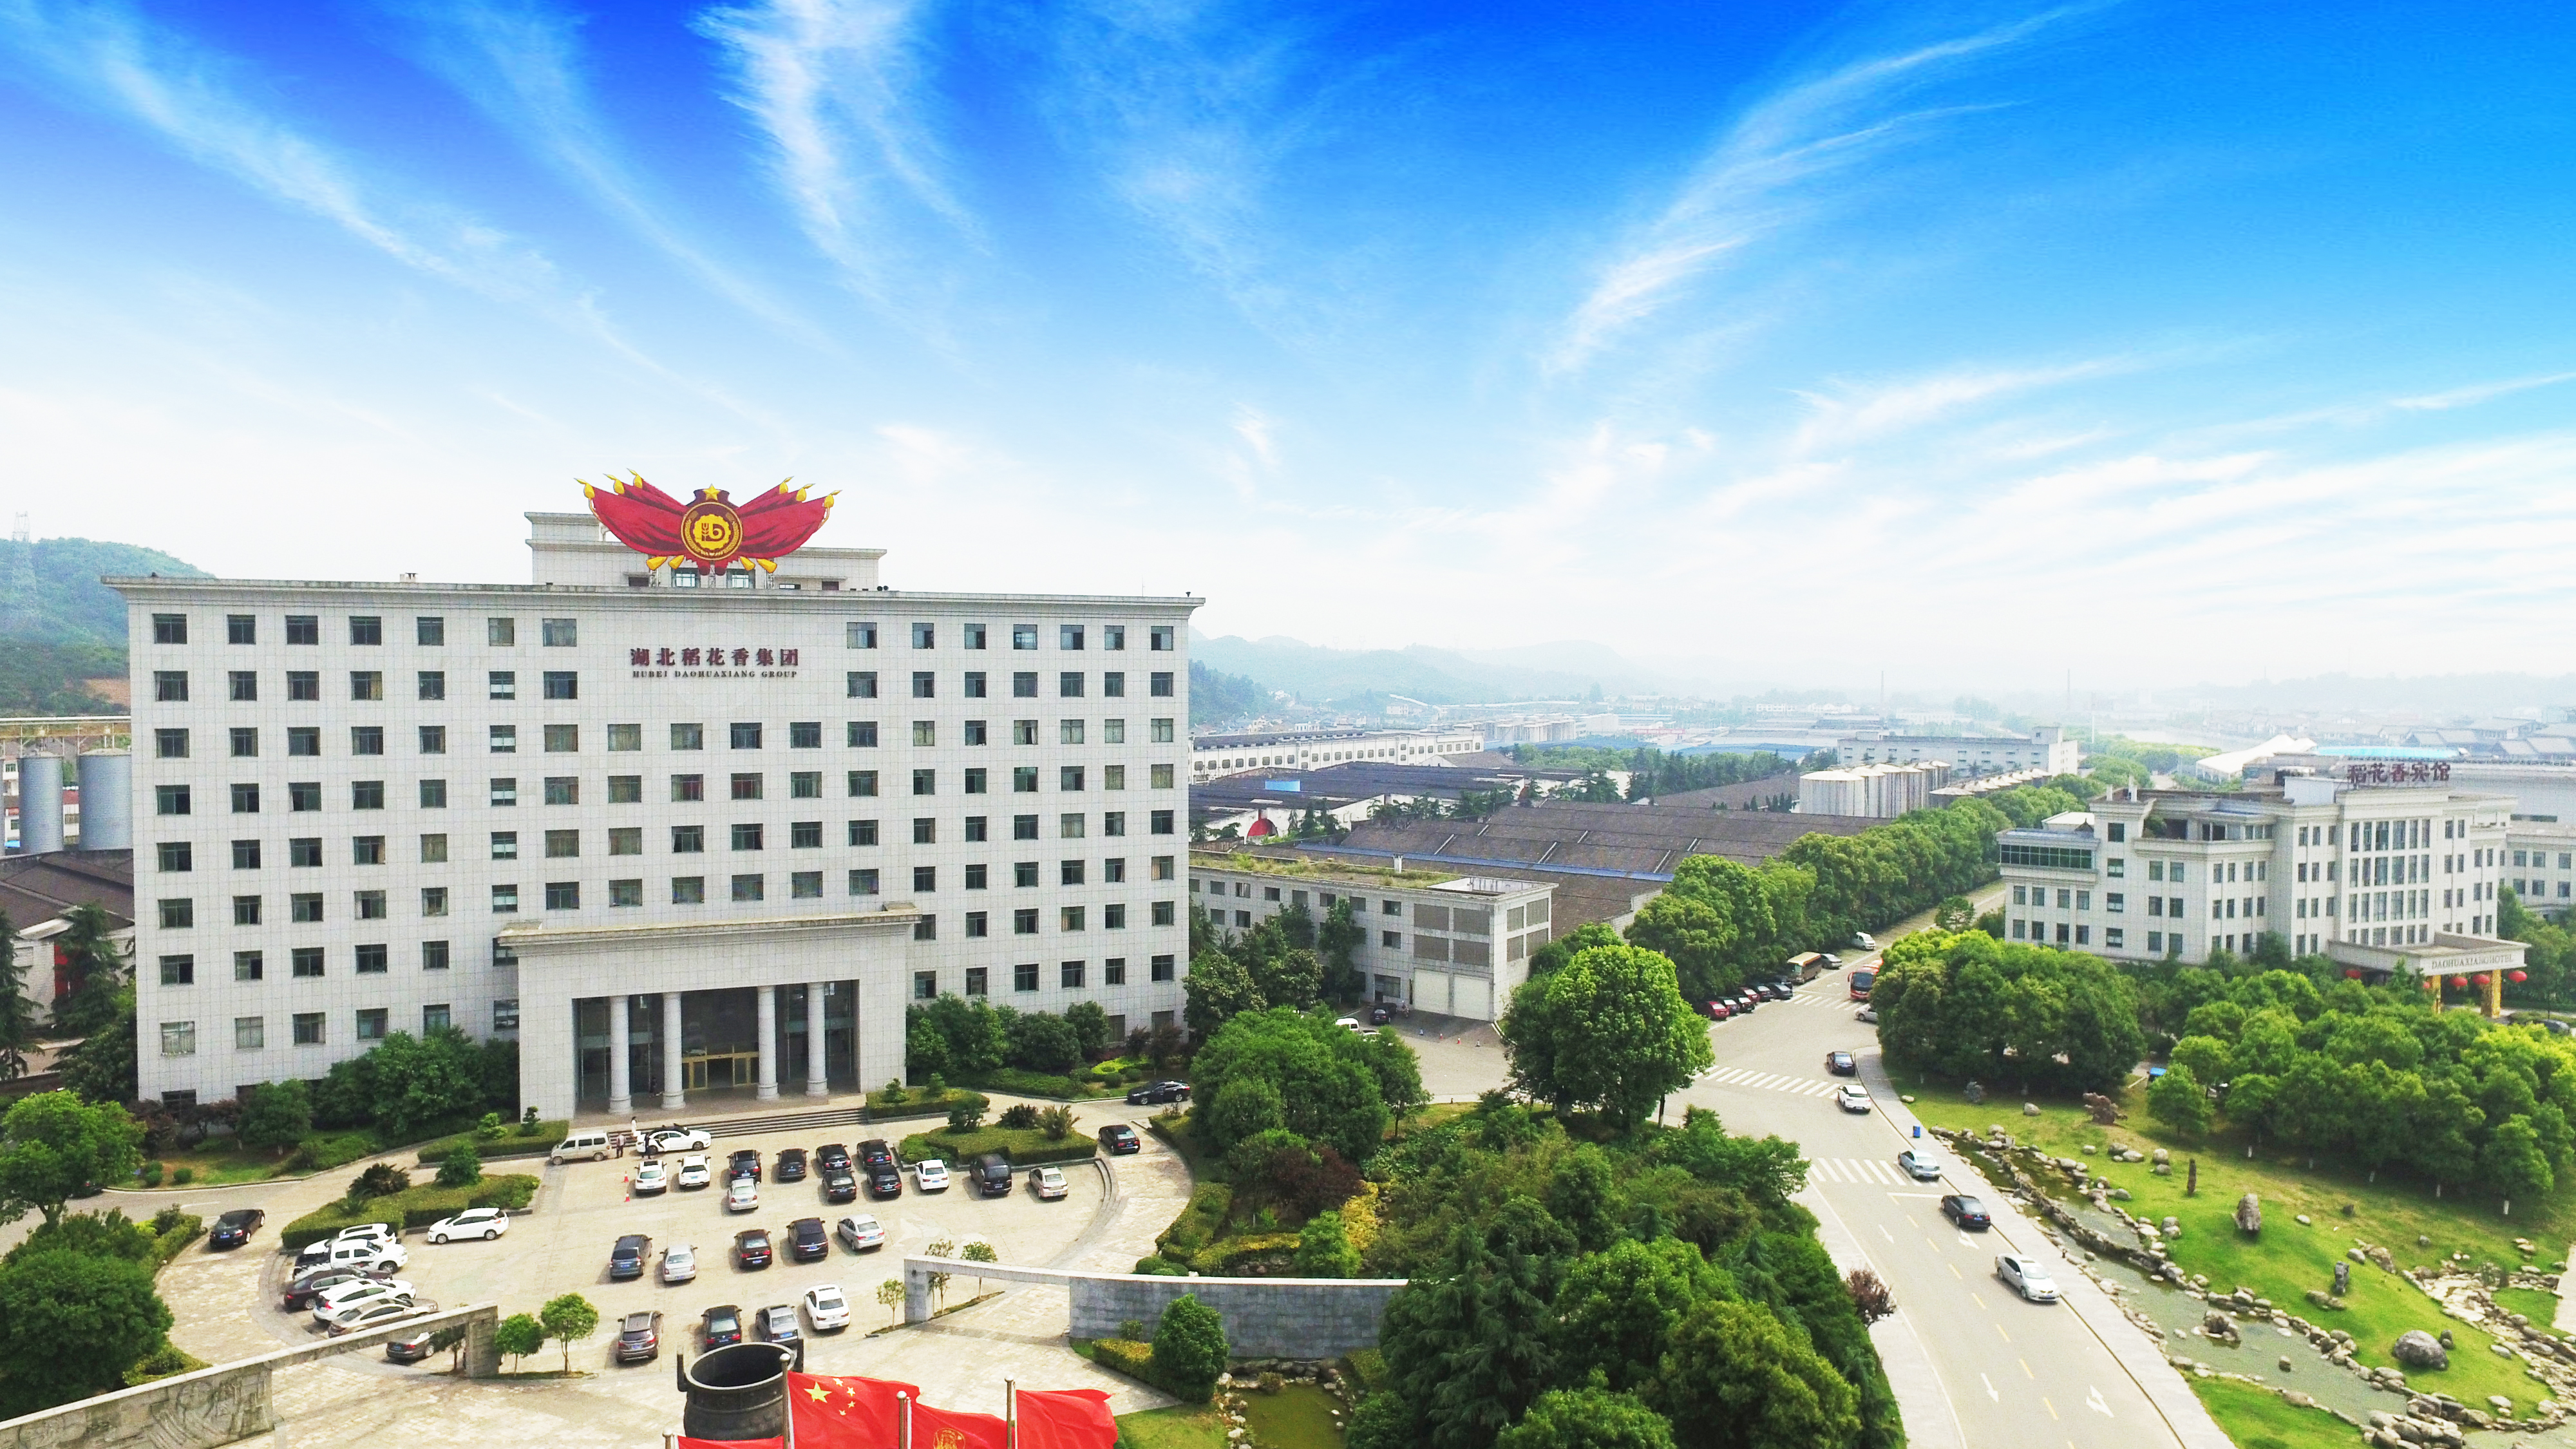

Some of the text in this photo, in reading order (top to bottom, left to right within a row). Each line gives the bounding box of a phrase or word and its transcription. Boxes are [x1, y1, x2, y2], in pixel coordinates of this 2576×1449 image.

[630, 647, 799, 667] 湖北稻花香集团
[675, 670, 755, 678] DAOHUAXIANG
[2347, 761, 2451, 784] 稻花香宾馆
